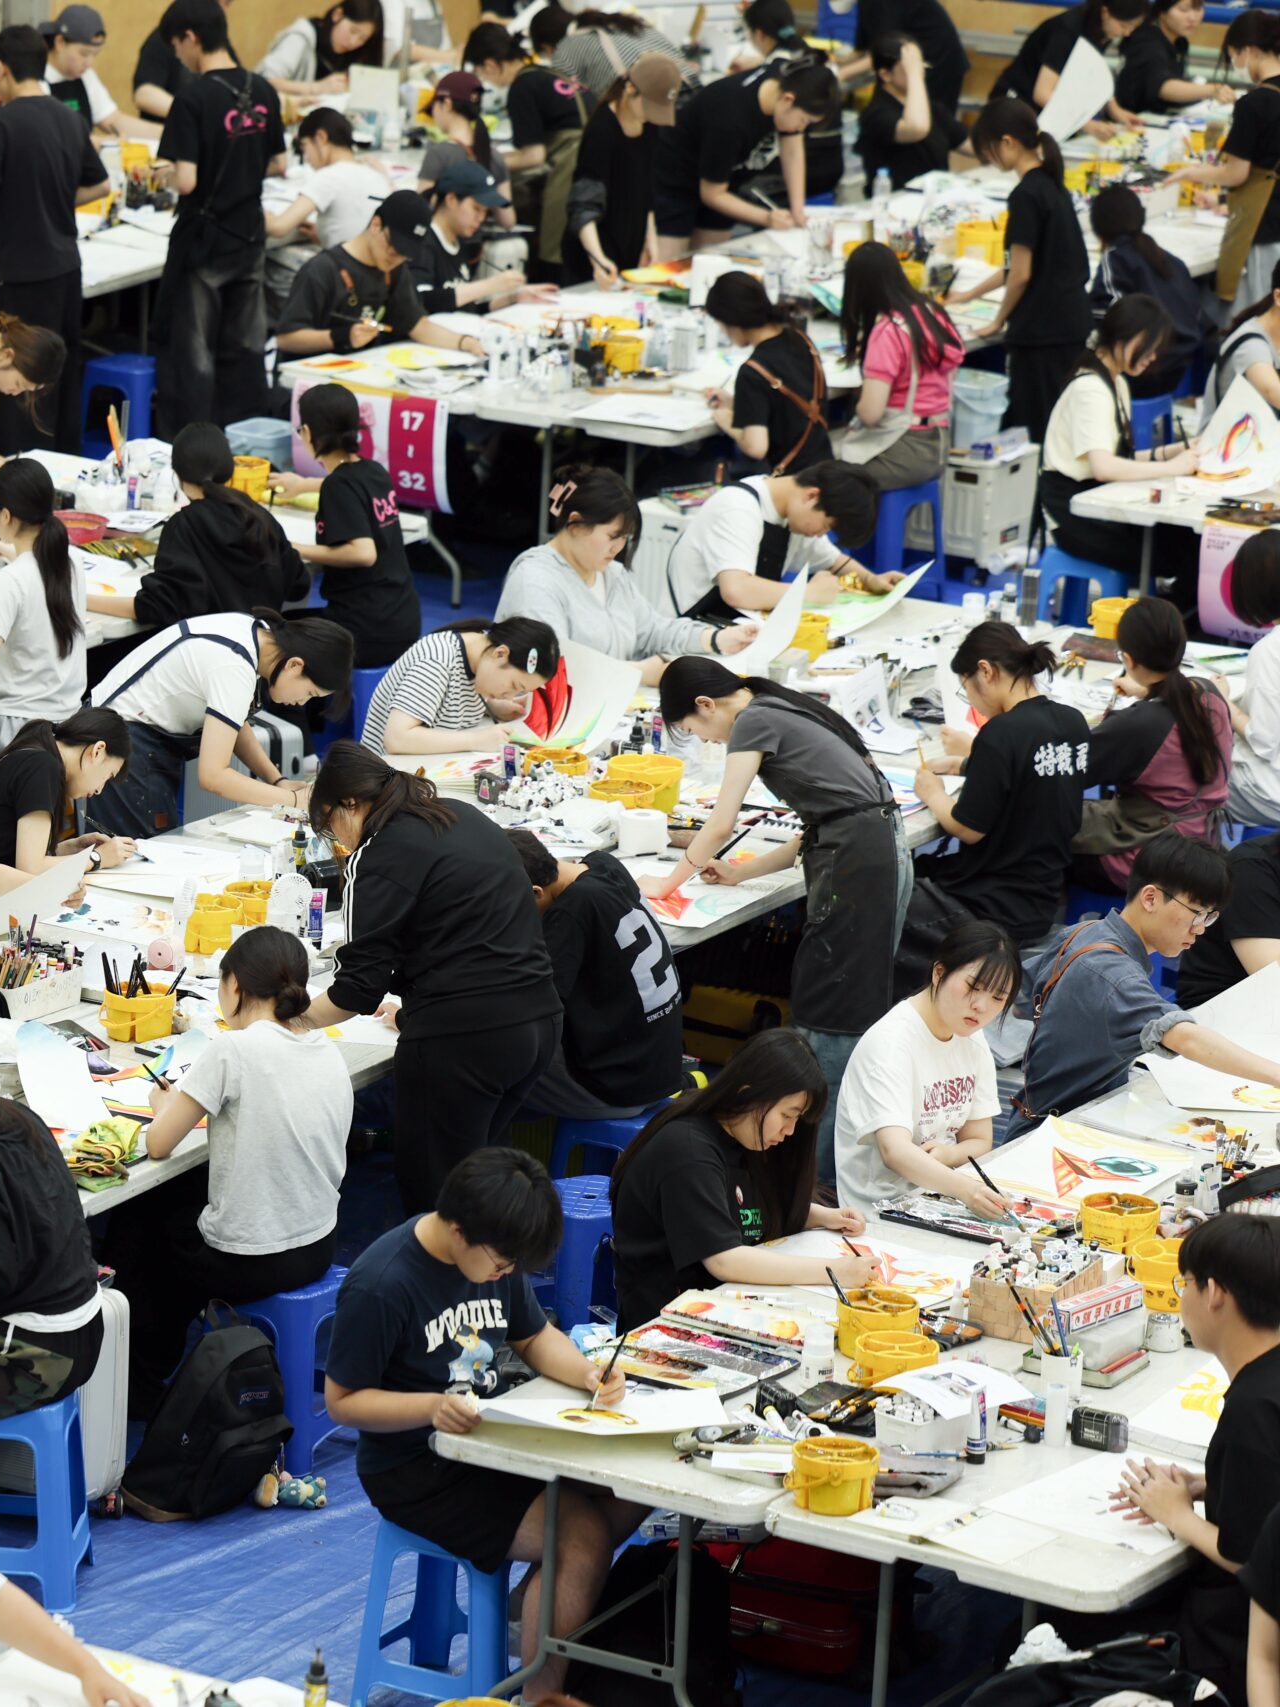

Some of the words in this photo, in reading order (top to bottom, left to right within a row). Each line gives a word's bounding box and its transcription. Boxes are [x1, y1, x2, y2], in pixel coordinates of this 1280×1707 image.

[400, 410, 425, 432] 17
[397, 470, 427, 492] 32
[424, 1299, 508, 1354] WOODIE
